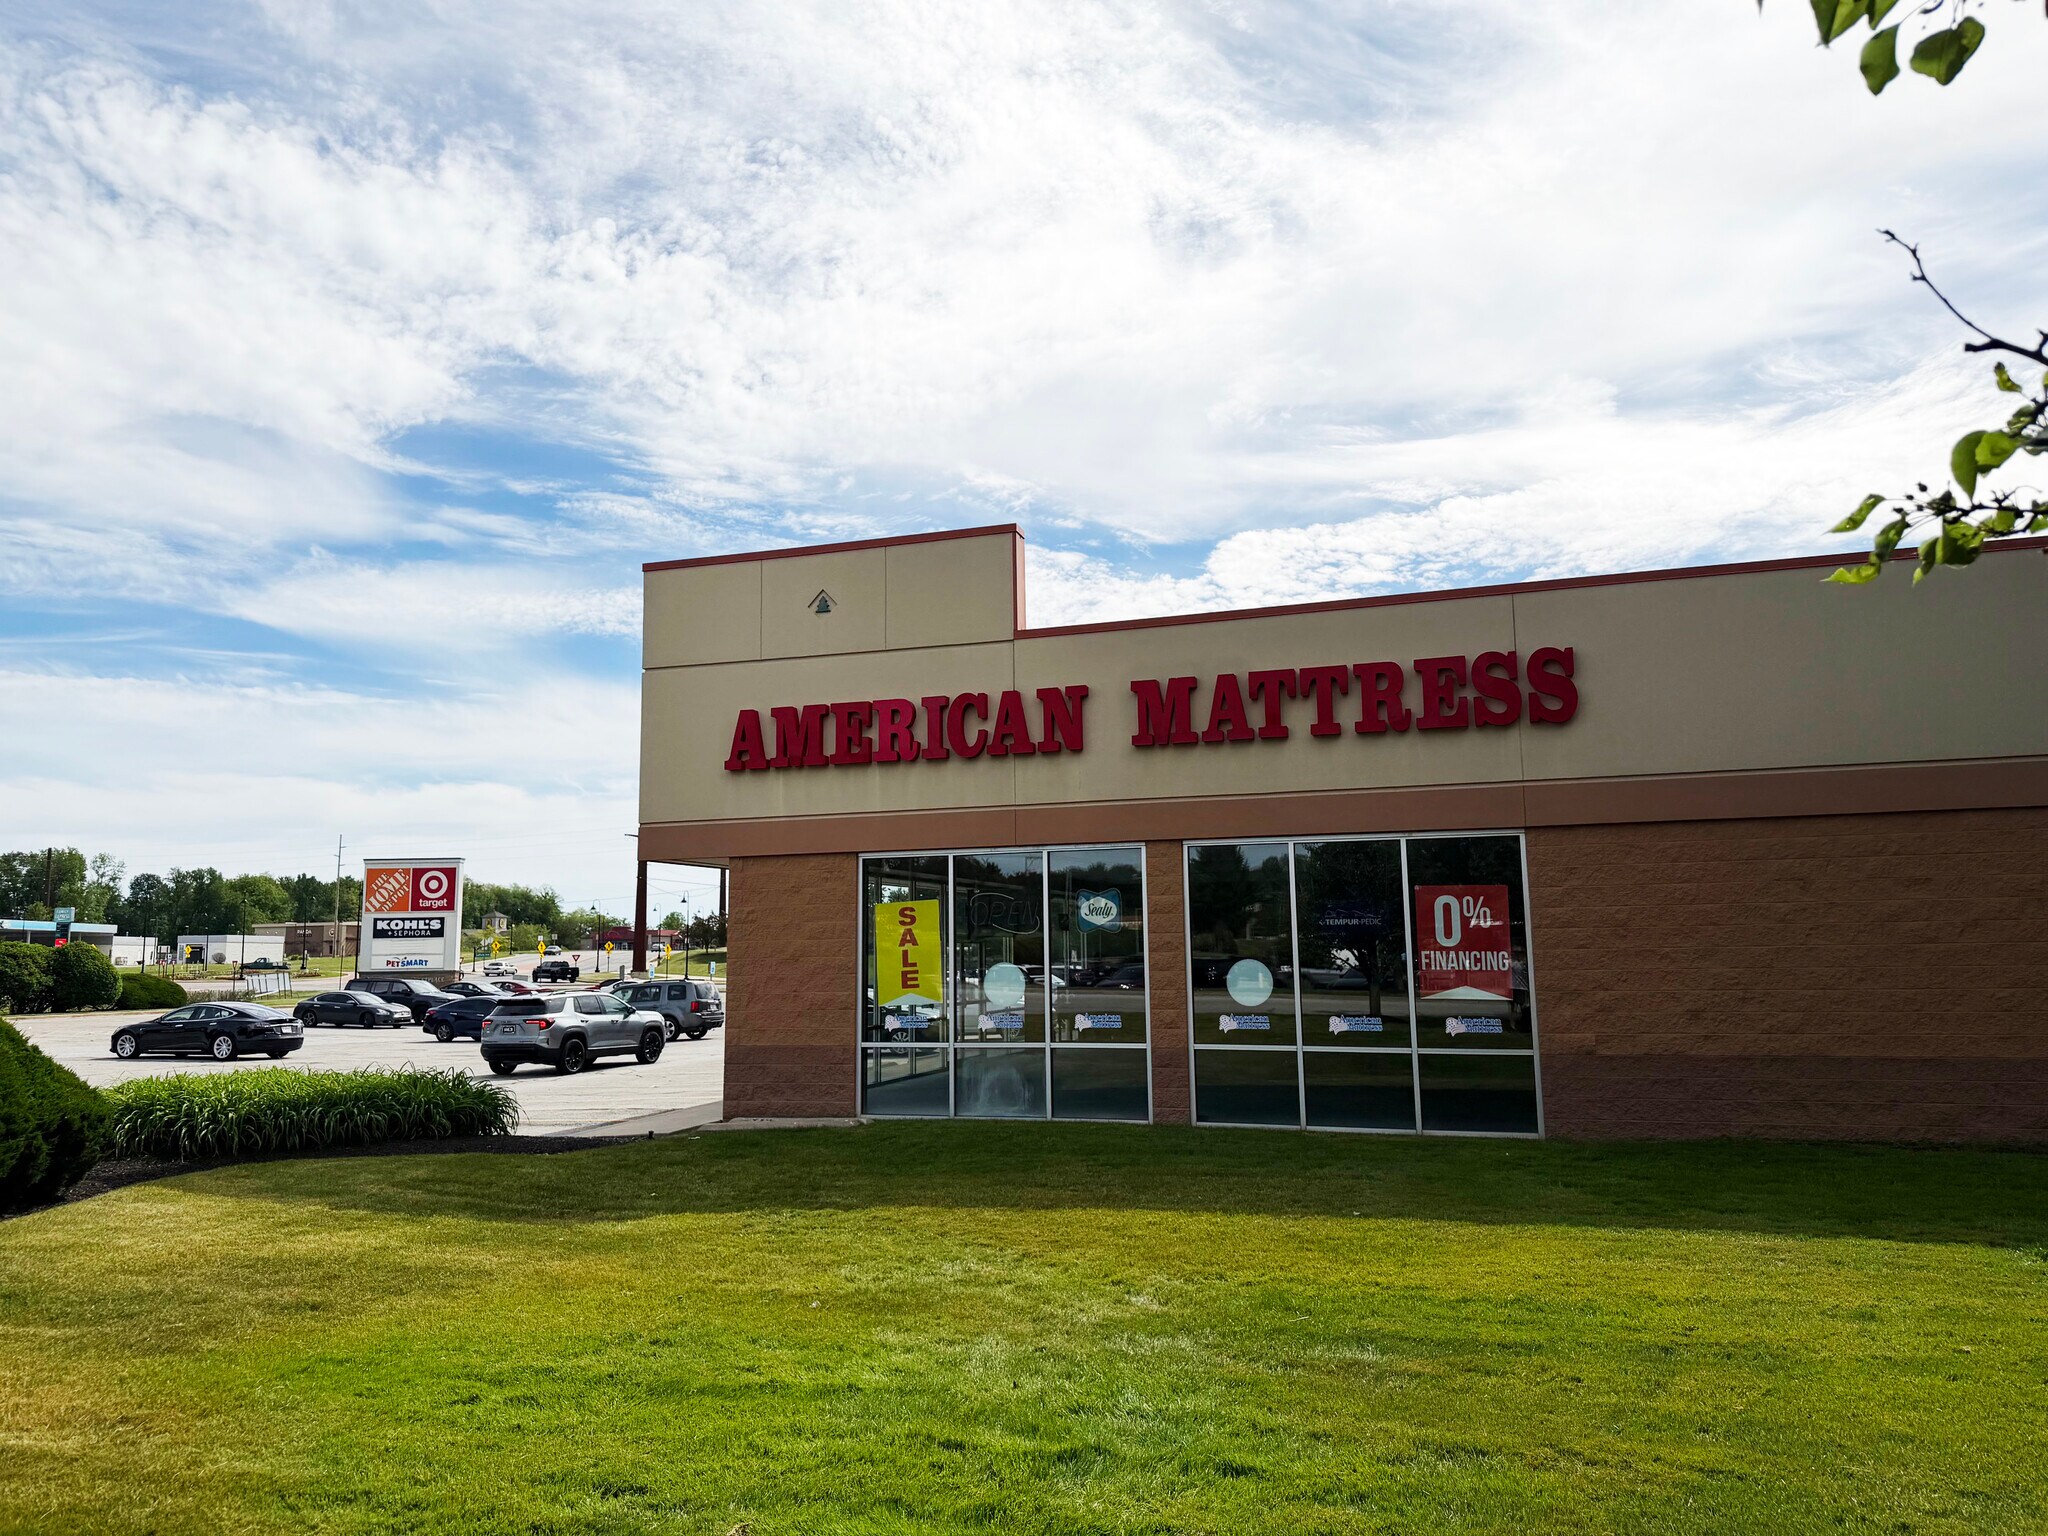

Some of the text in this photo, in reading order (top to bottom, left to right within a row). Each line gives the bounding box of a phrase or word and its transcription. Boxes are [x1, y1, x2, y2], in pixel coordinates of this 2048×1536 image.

[724, 647, 1579, 771] AMERICAN MATTRESS
[370, 872, 390, 890] THE
[366, 868, 409, 912] HOME
[382, 884, 410, 912] DEPOT
[419, 899, 447, 908] target
[1084, 902, 1112, 918] Sealy
[376, 919, 442, 930] KOHL'S
[1325, 917, 1382, 926] TEMPUR-PEDIC
[1434, 895, 1491, 947] 0%
[898, 907, 920, 989] SALE
[386, 959, 429, 967] PETSMART
[1421, 951, 1510, 971] FINANCING
[1340, 1014, 1382, 1024] American
[1457, 1015, 1502, 1025] American
